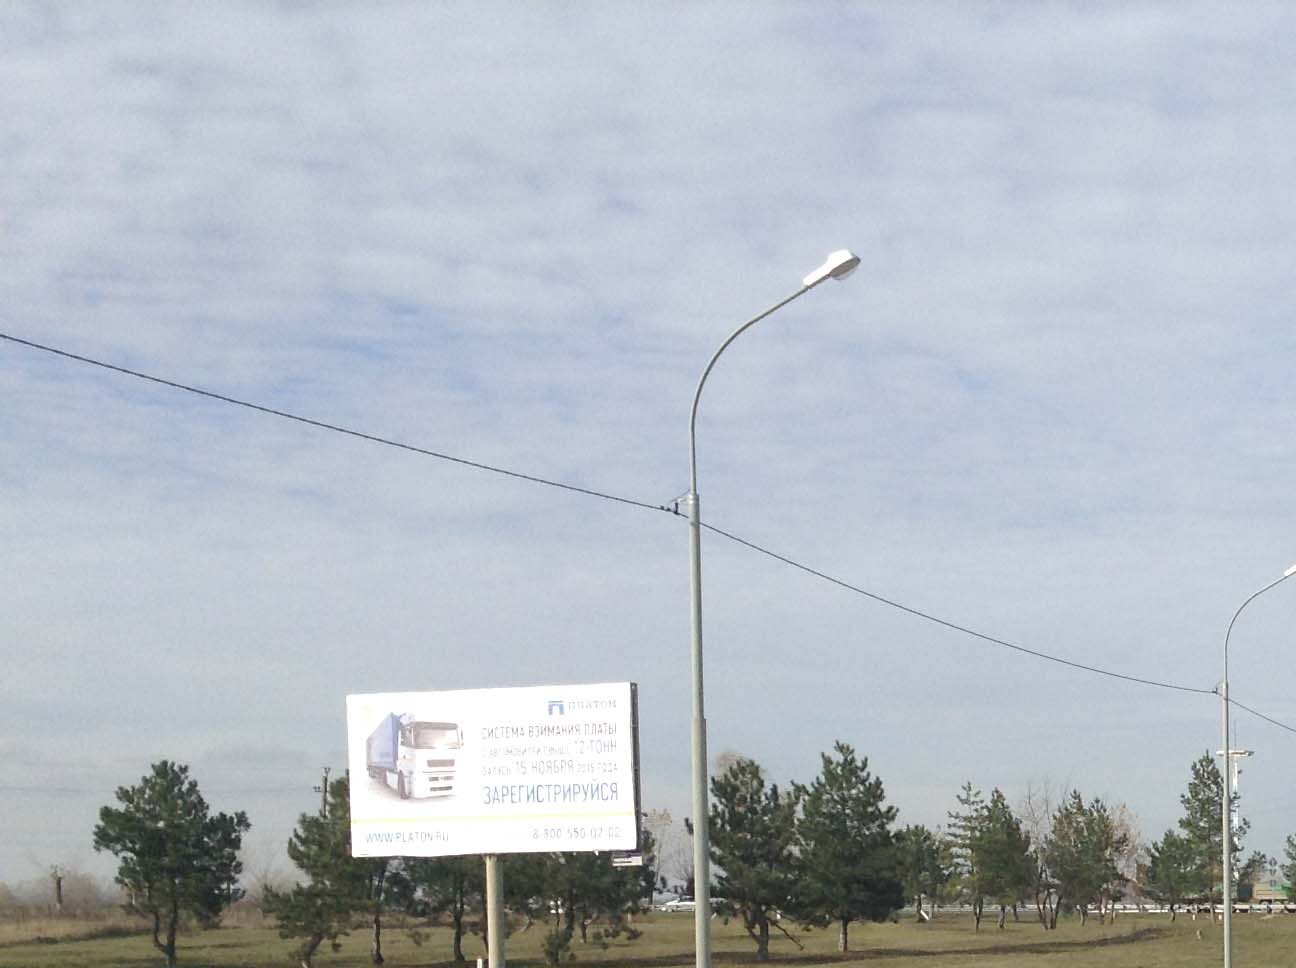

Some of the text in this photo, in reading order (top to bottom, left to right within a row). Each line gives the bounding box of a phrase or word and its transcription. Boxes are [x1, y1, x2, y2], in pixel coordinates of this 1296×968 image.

[481, 721, 617, 740] СИСТЕМА ВЗИМАНИЯ ПЛАТЫ
[515, 761, 527, 775] 15
[531, 759, 574, 775] НОЯБРЯ
[483, 778, 618, 805] ЗАРЕГИСТРИРУЙСЯ
